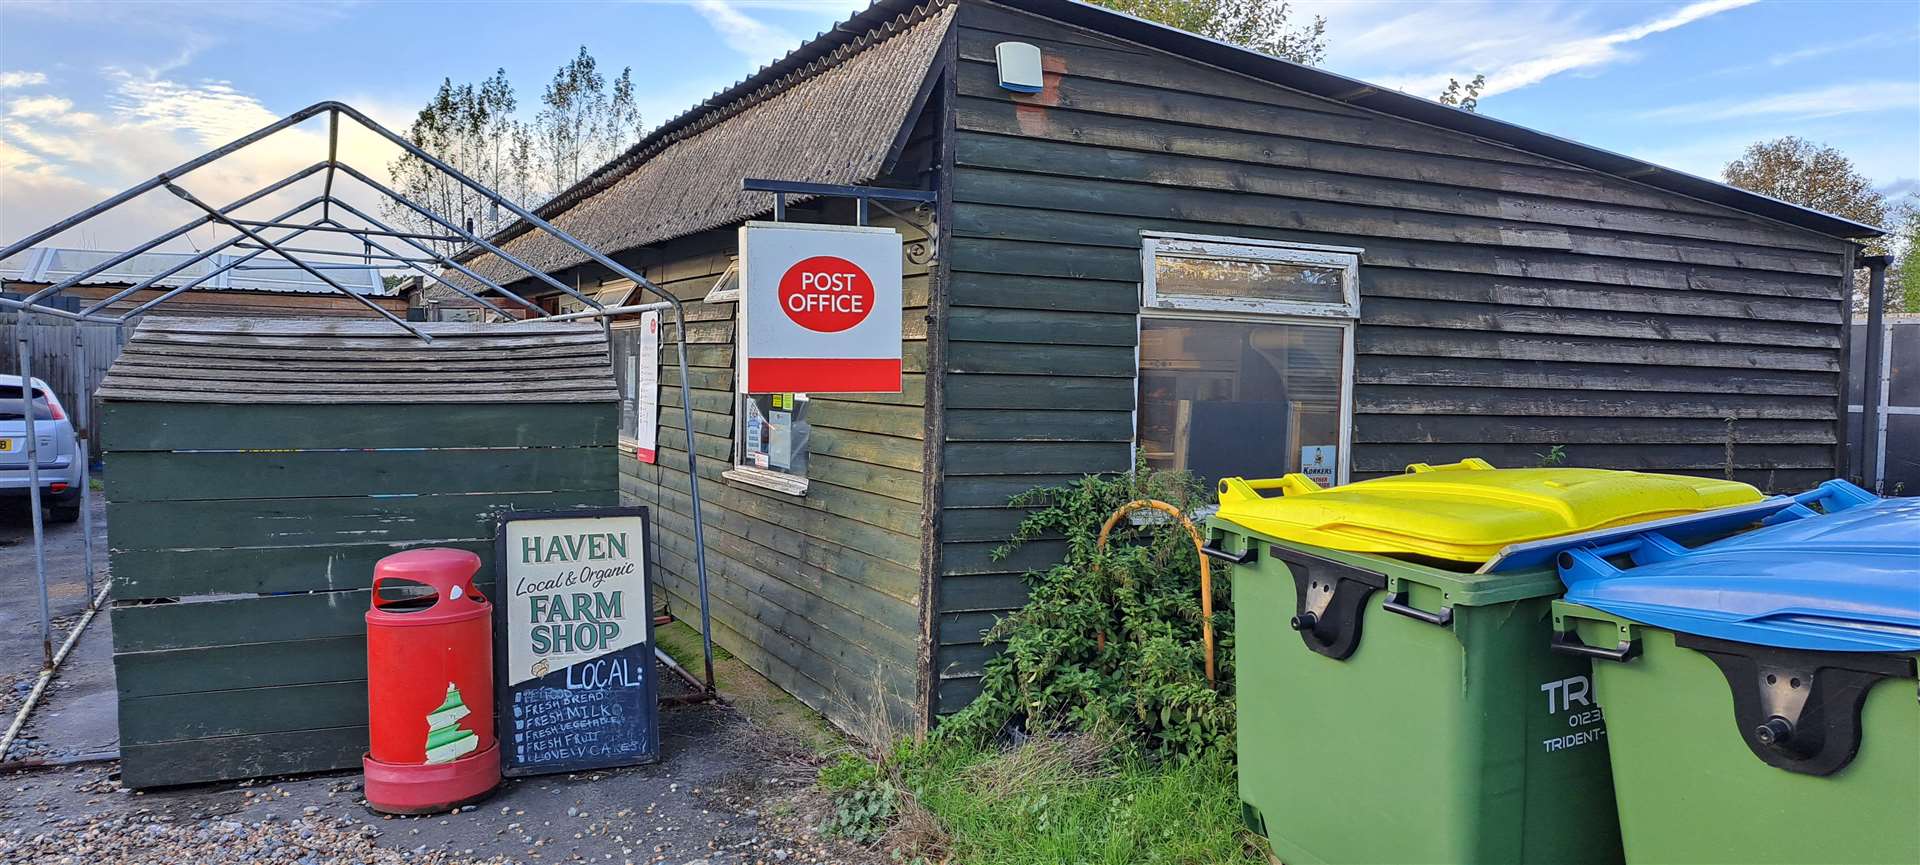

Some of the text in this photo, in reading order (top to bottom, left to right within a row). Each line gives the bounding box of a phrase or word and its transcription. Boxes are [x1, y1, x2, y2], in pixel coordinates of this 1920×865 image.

[801, 272, 856, 291] POST
[788, 293, 863, 313] OFFICE
[521, 532, 629, 564] HAVEN
[516, 561, 635, 596] Local & Organic
[529, 590, 625, 625] FARM
[530, 621, 622, 655] SHOP
[566, 658, 644, 690] LOCAL:
[525, 699, 560, 719] FRESH
[526, 703, 611, 729] FRESH MILK
[1569, 709, 1604, 727] 0123
[526, 725, 558, 743] FRESH
[526, 731, 601, 753] FRESH FRUIT
